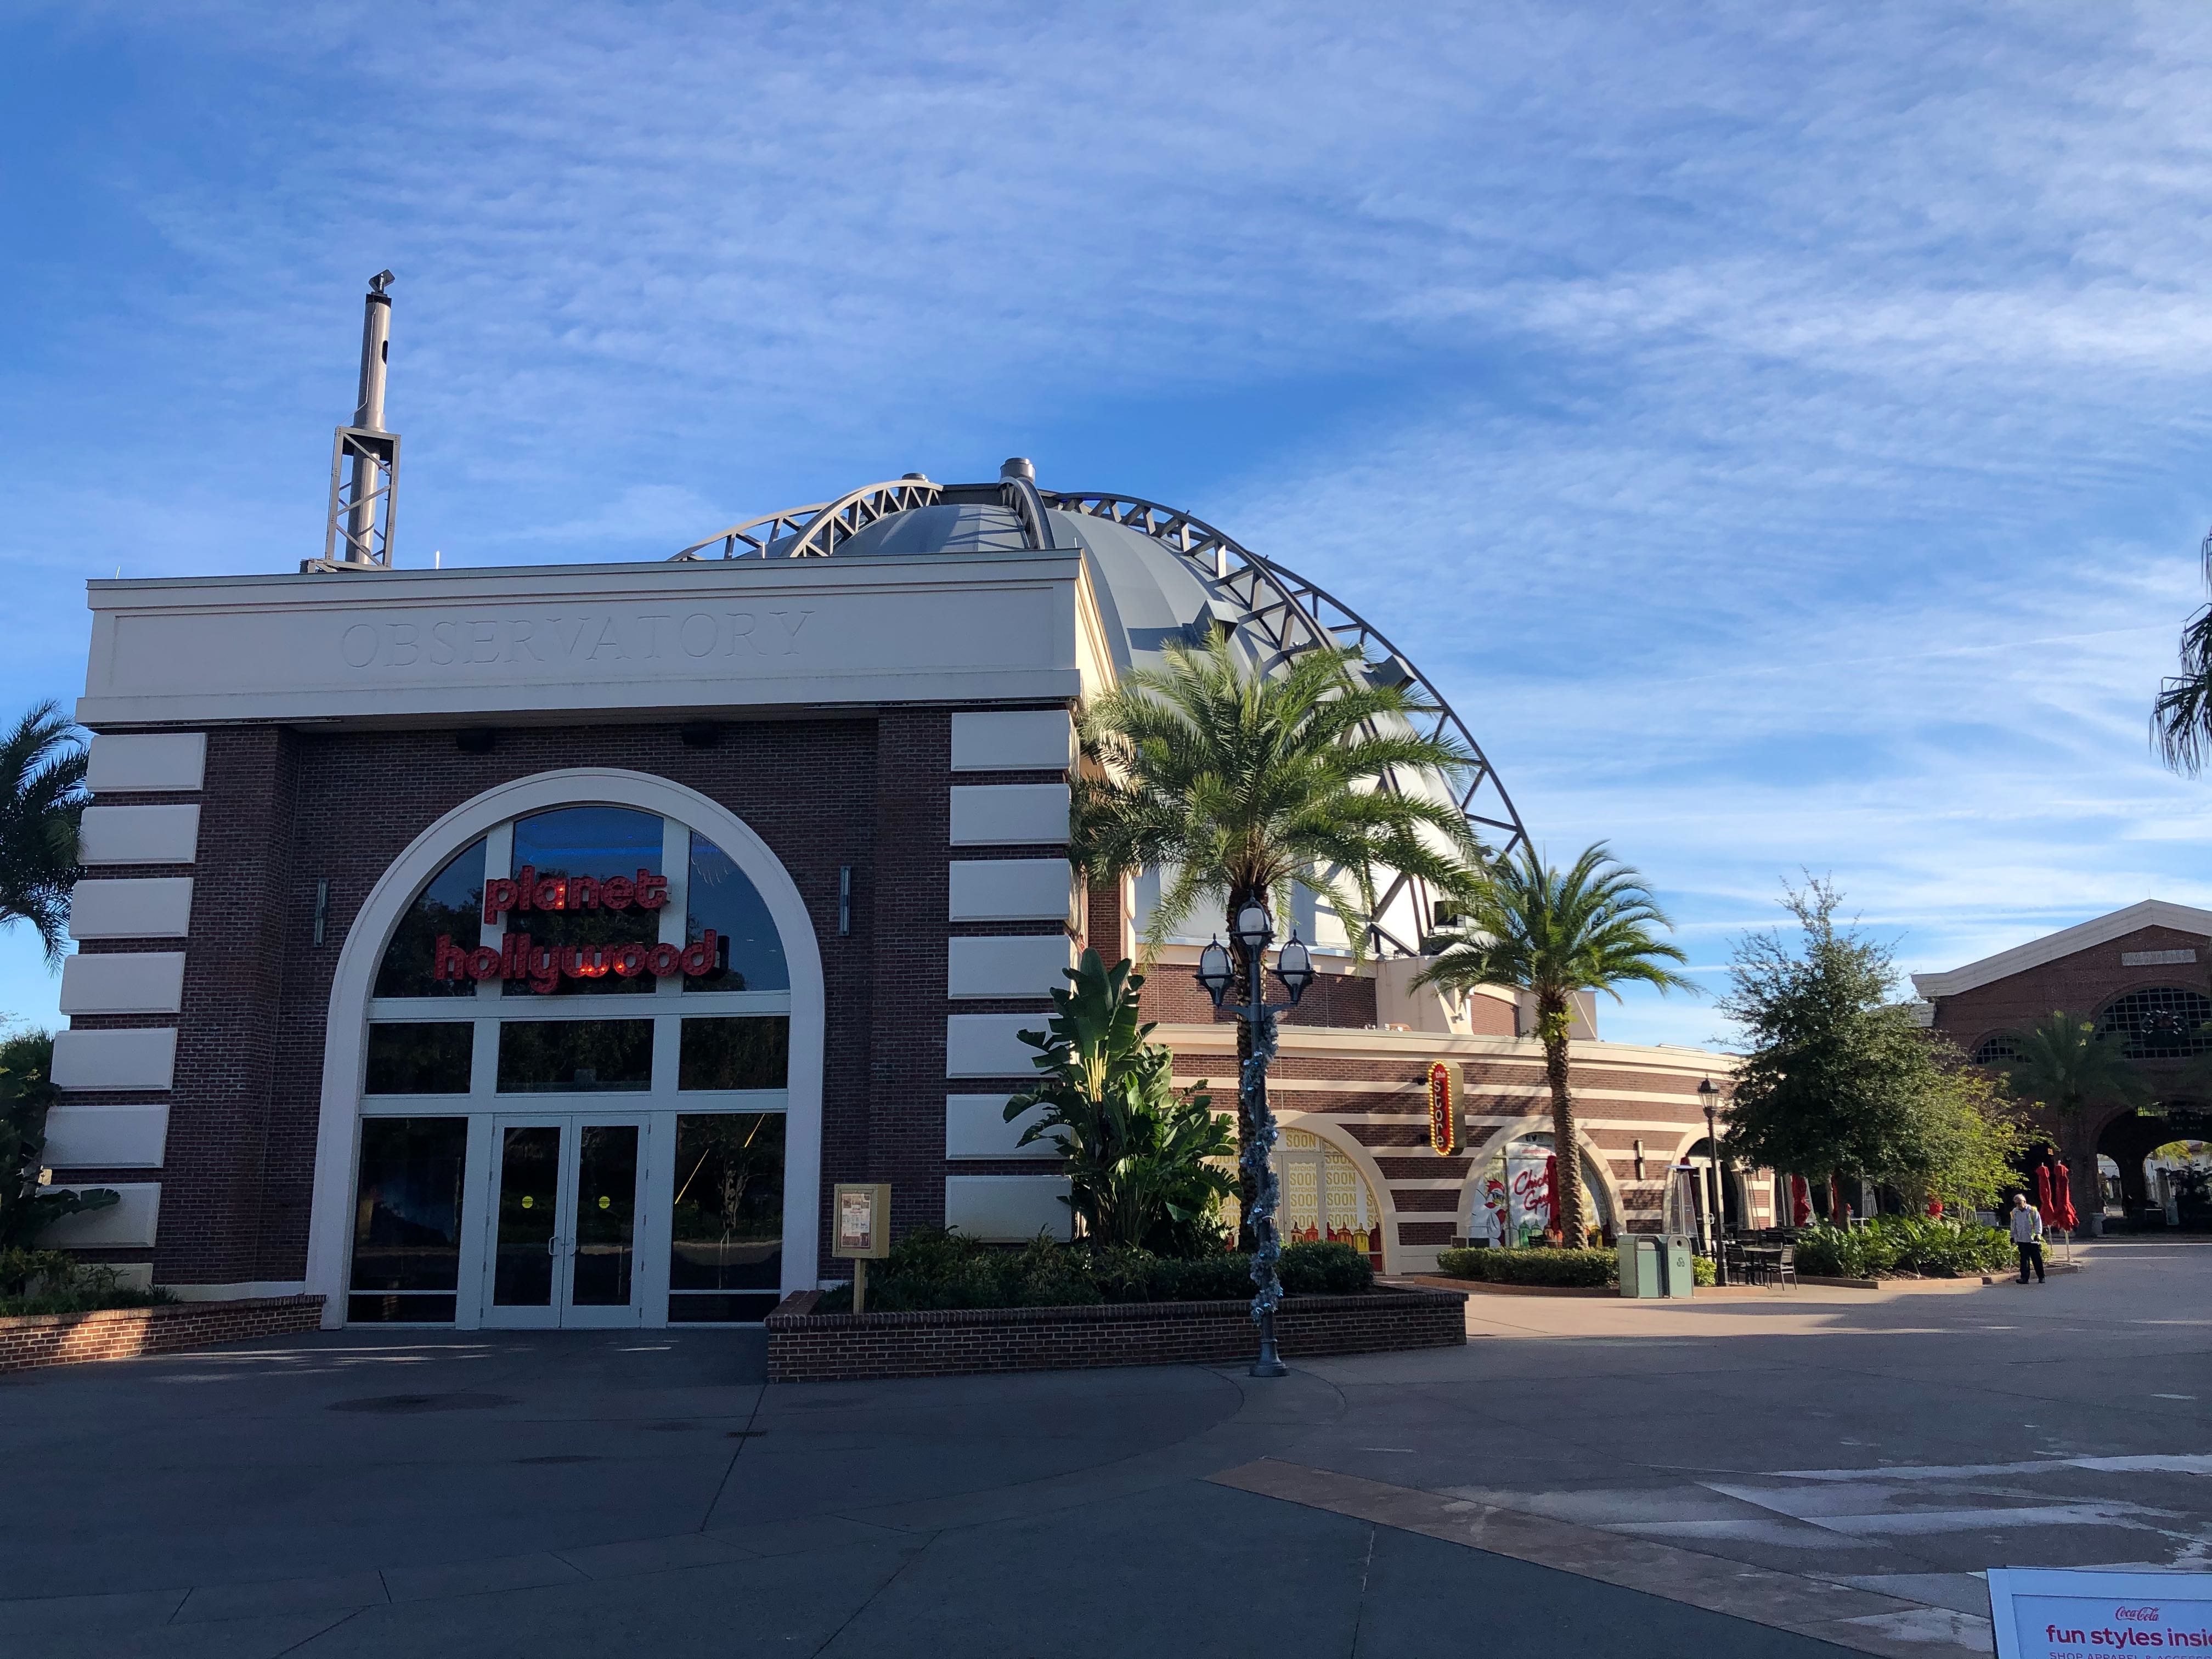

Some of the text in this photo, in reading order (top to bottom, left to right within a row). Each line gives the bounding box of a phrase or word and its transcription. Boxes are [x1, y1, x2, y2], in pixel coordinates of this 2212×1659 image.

[342, 610, 816, 668] OBSERVATORY
[484, 865, 667, 925] planet
[435, 929, 718, 994] hollywood
[1434, 1080, 1444, 1148] store
[1286, 1134, 1316, 1148] SOON
[1326, 1172, 1356, 1185] SOON
[1327, 1193, 1357, 1206] SOON
[1328, 1214, 1357, 1227] SOON
[2046, 1624, 2085, 1644] fun
[2091, 1627, 2164, 1649] styles
